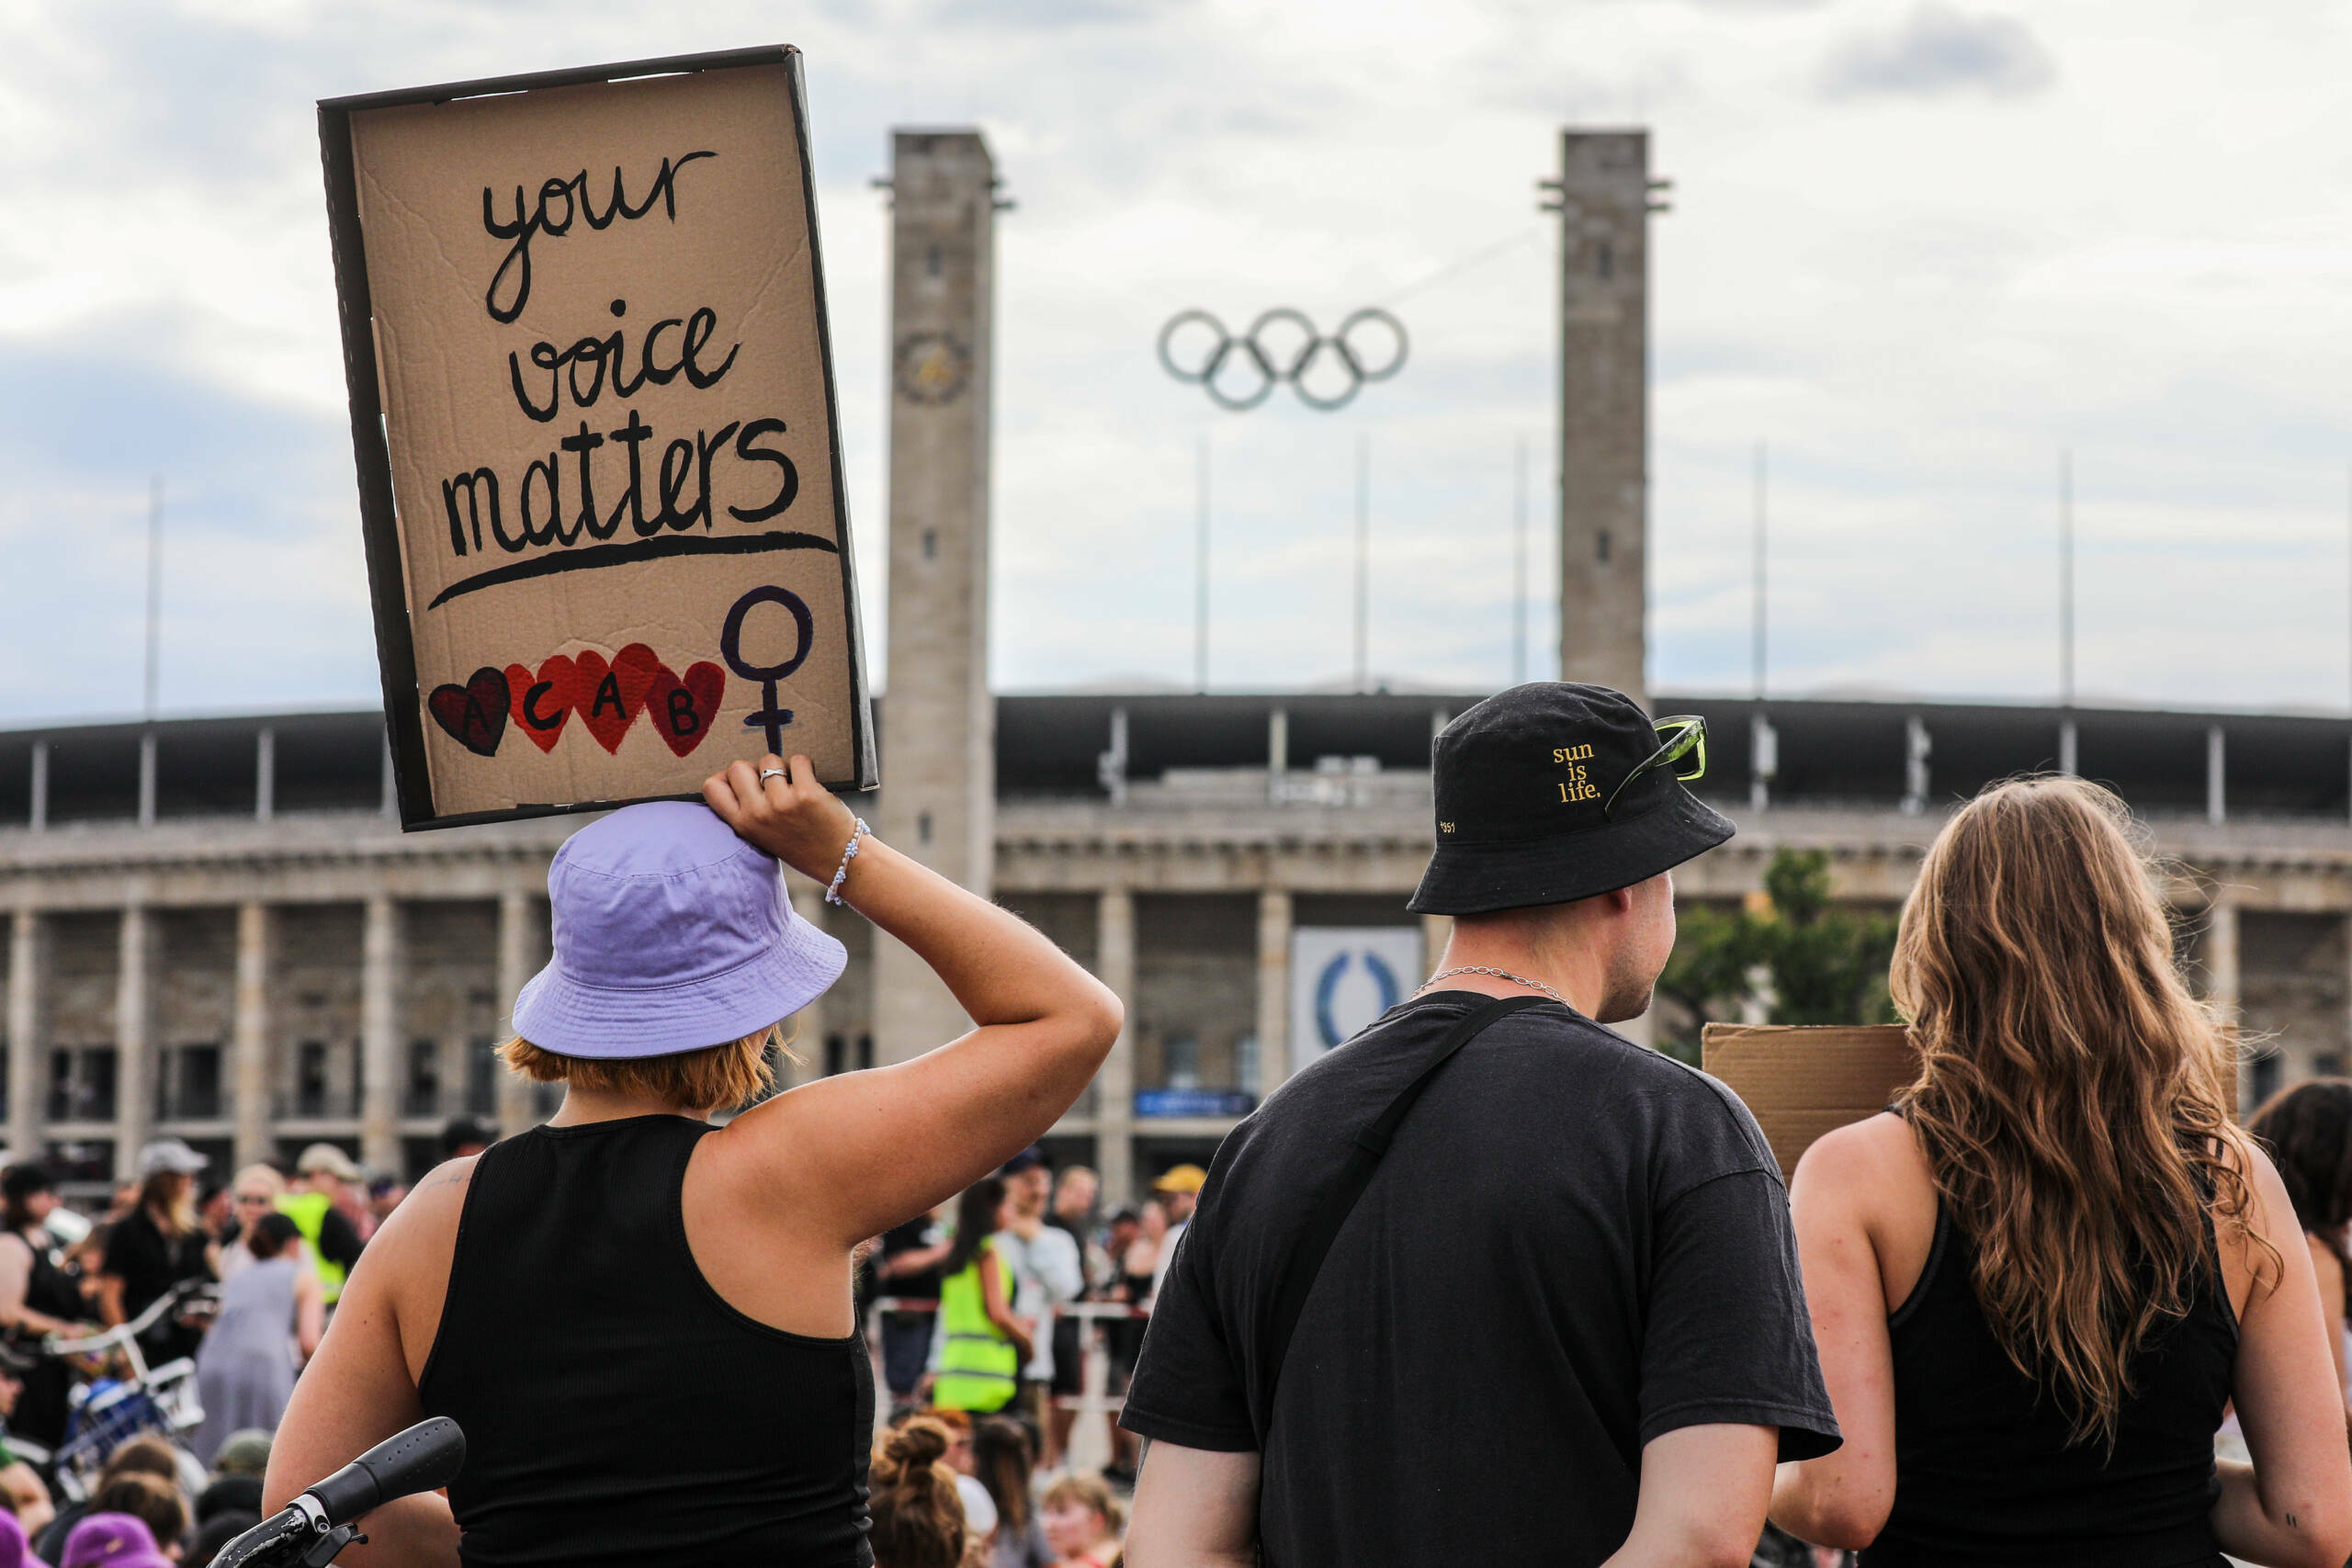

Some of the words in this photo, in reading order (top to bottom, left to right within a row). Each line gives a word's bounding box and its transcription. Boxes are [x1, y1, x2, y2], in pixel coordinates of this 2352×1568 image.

[482, 151, 718, 323] your
[509, 299, 742, 422] voice
[442, 410, 798, 556] matters
[1553, 743, 1595, 763] sun
[1567, 761, 1587, 782] is
[1557, 780, 1601, 802] life.
